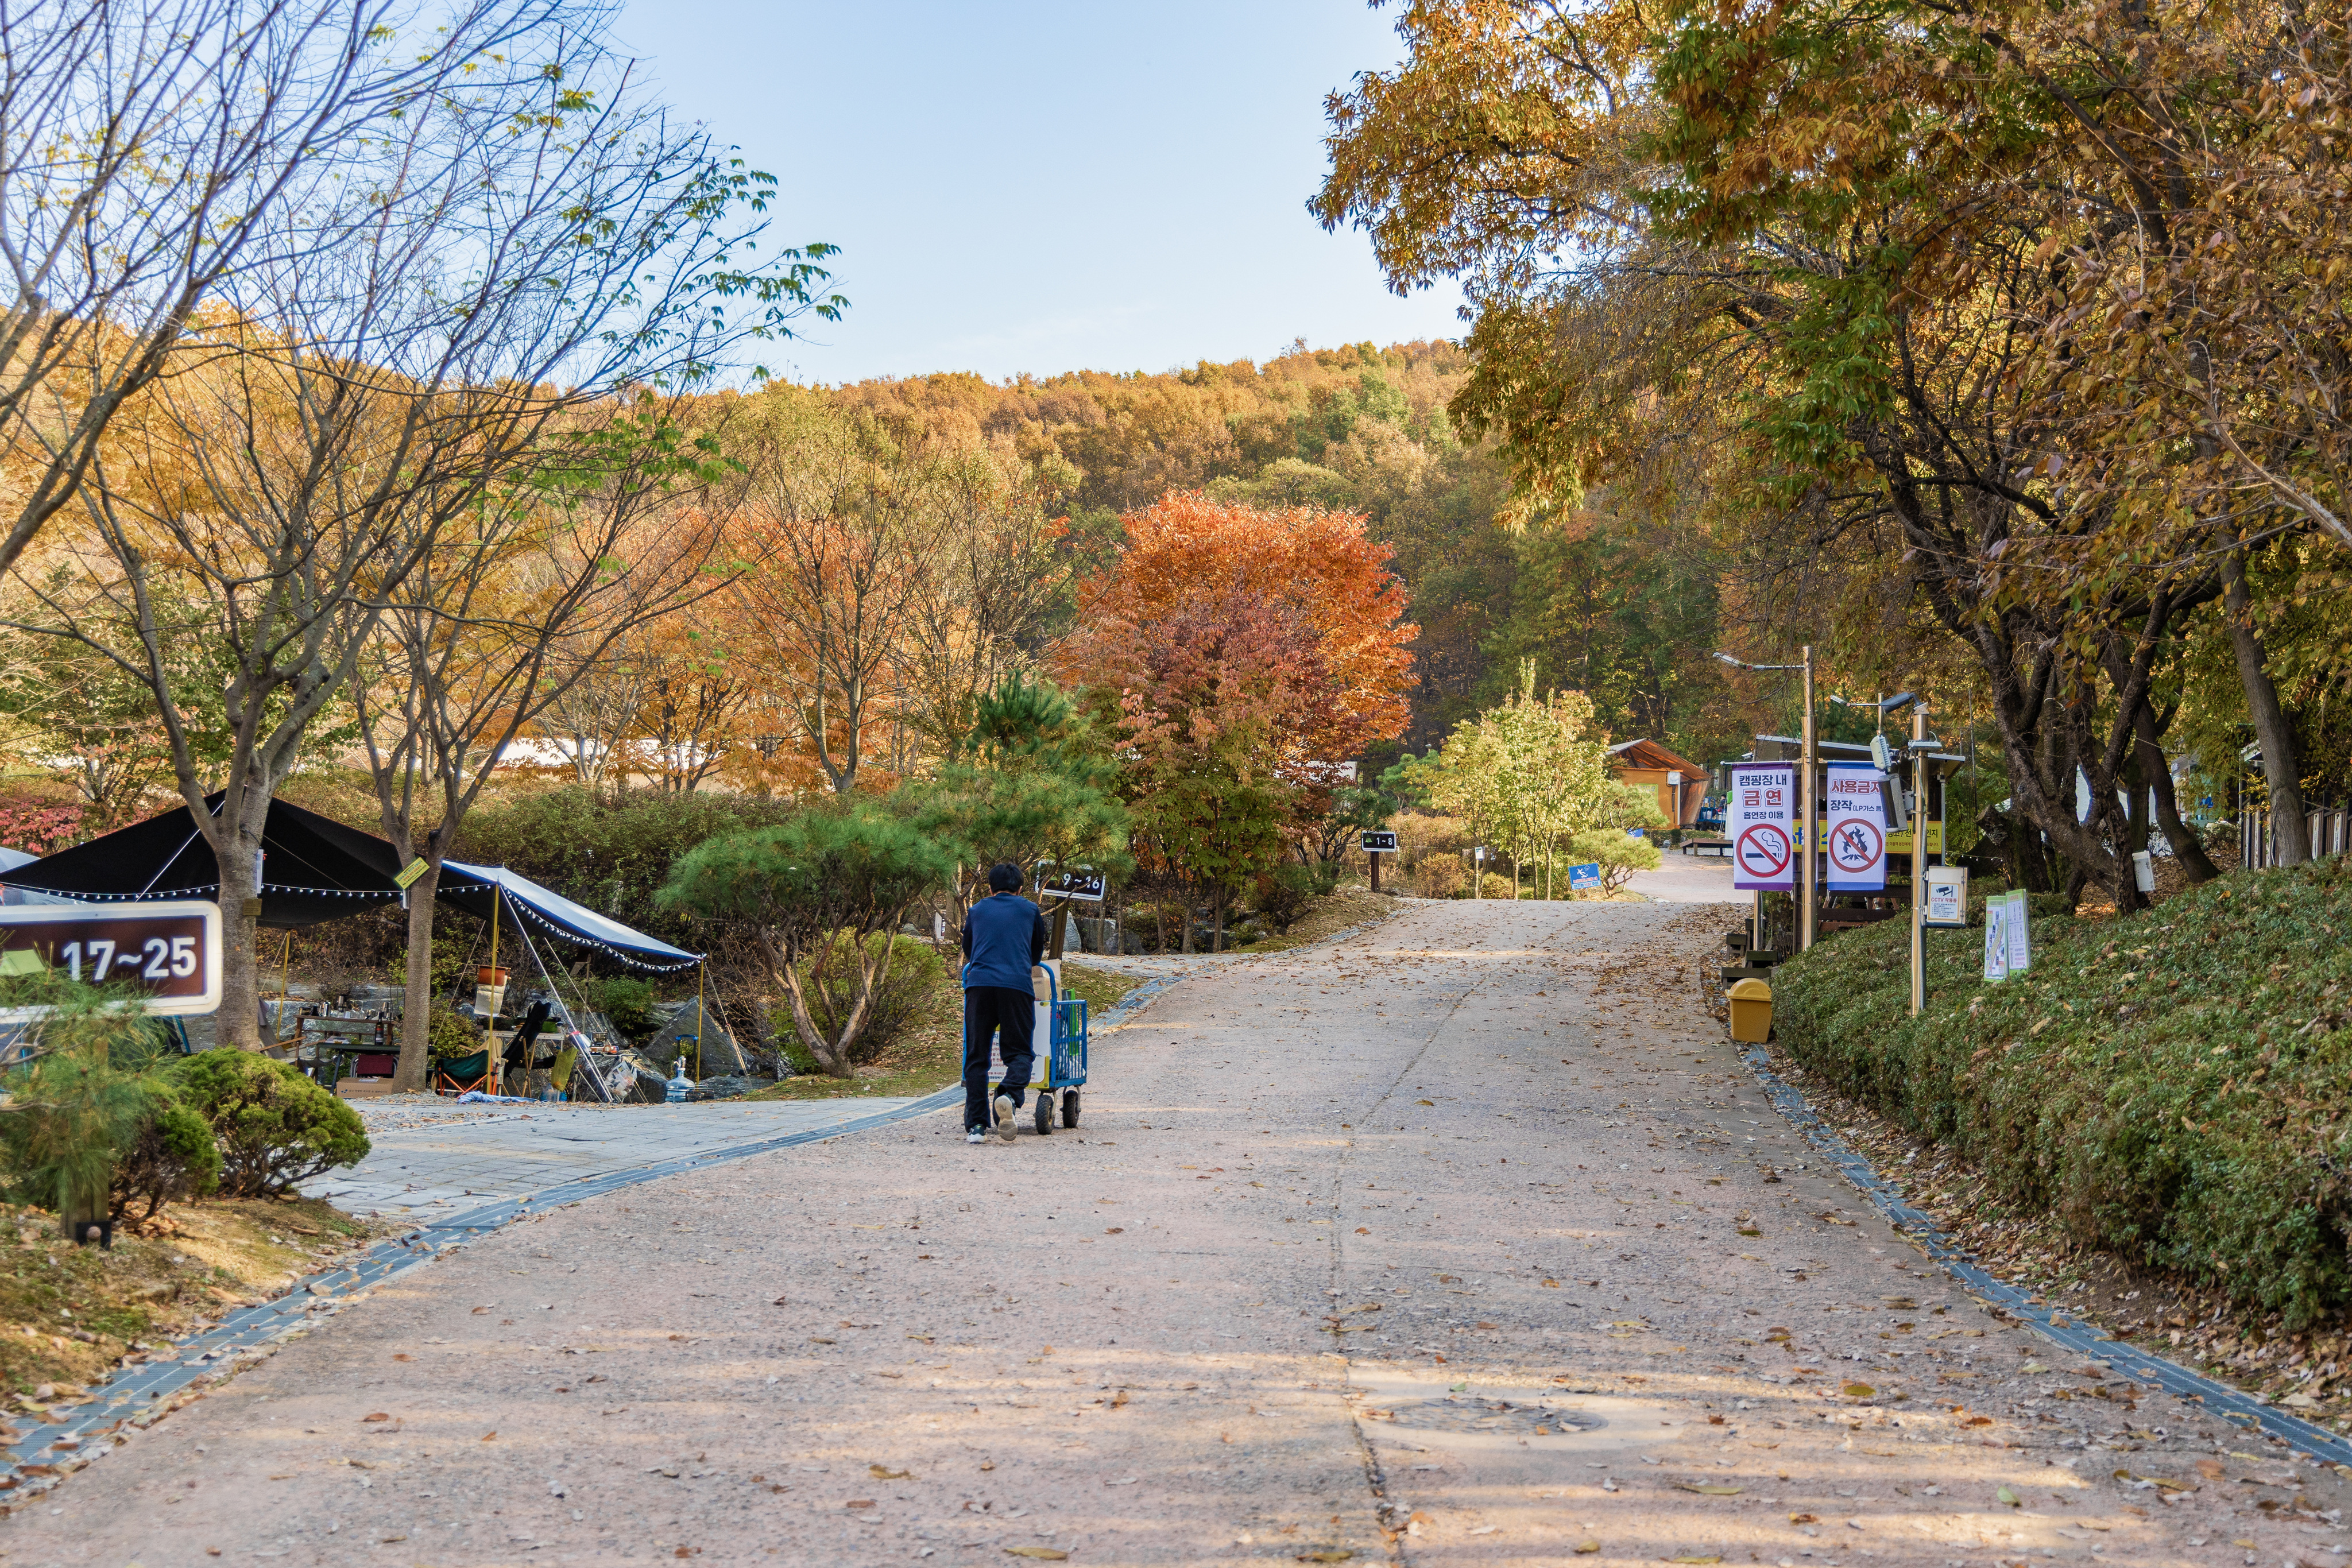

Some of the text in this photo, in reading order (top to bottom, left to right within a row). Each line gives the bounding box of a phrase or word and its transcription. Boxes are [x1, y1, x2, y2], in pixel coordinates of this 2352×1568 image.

[1739, 774, 1787, 786] 캠핑장 내
[1830, 800, 1852, 811] 장작
[1743, 811, 1784, 819] 흡연장 이용
[63, 936, 196, 981] 17~25
